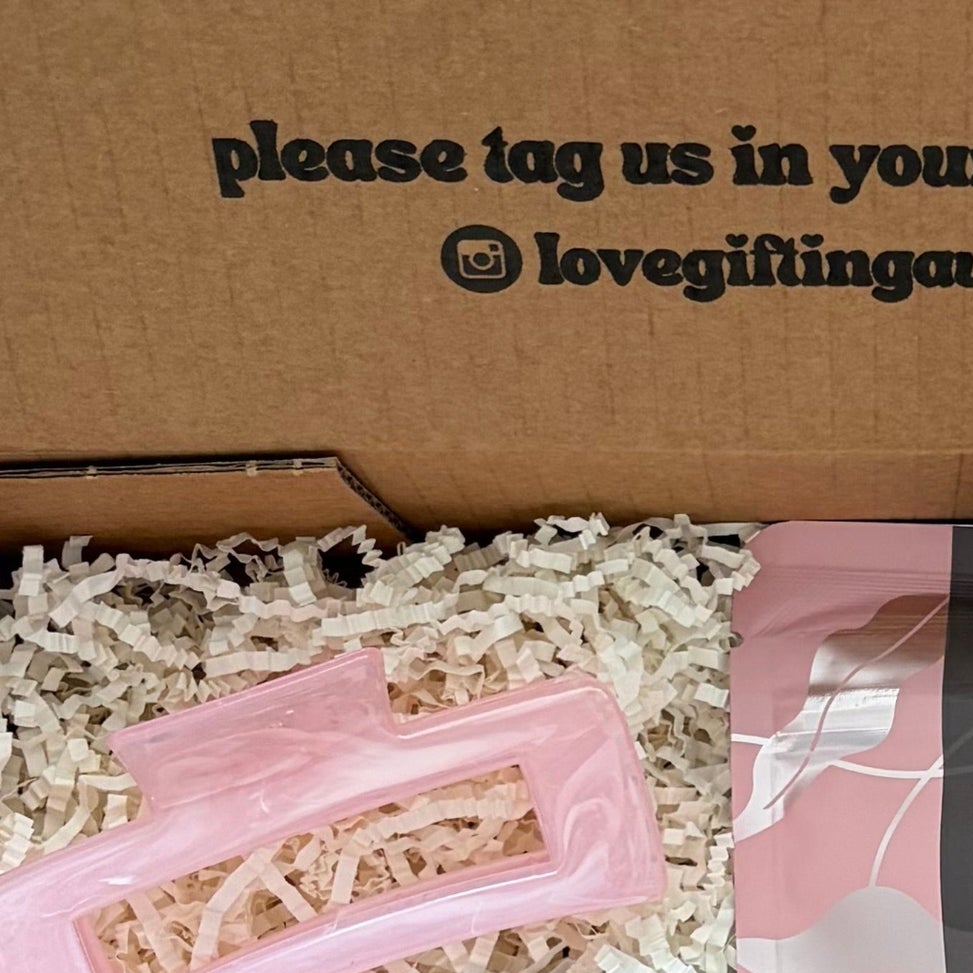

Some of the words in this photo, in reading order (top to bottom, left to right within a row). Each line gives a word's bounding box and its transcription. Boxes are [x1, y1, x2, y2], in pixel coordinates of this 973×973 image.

[212, 120, 467, 198] please
[482, 127, 604, 202] tag
[621, 143, 714, 185] us
[730, 125, 813, 185] in
